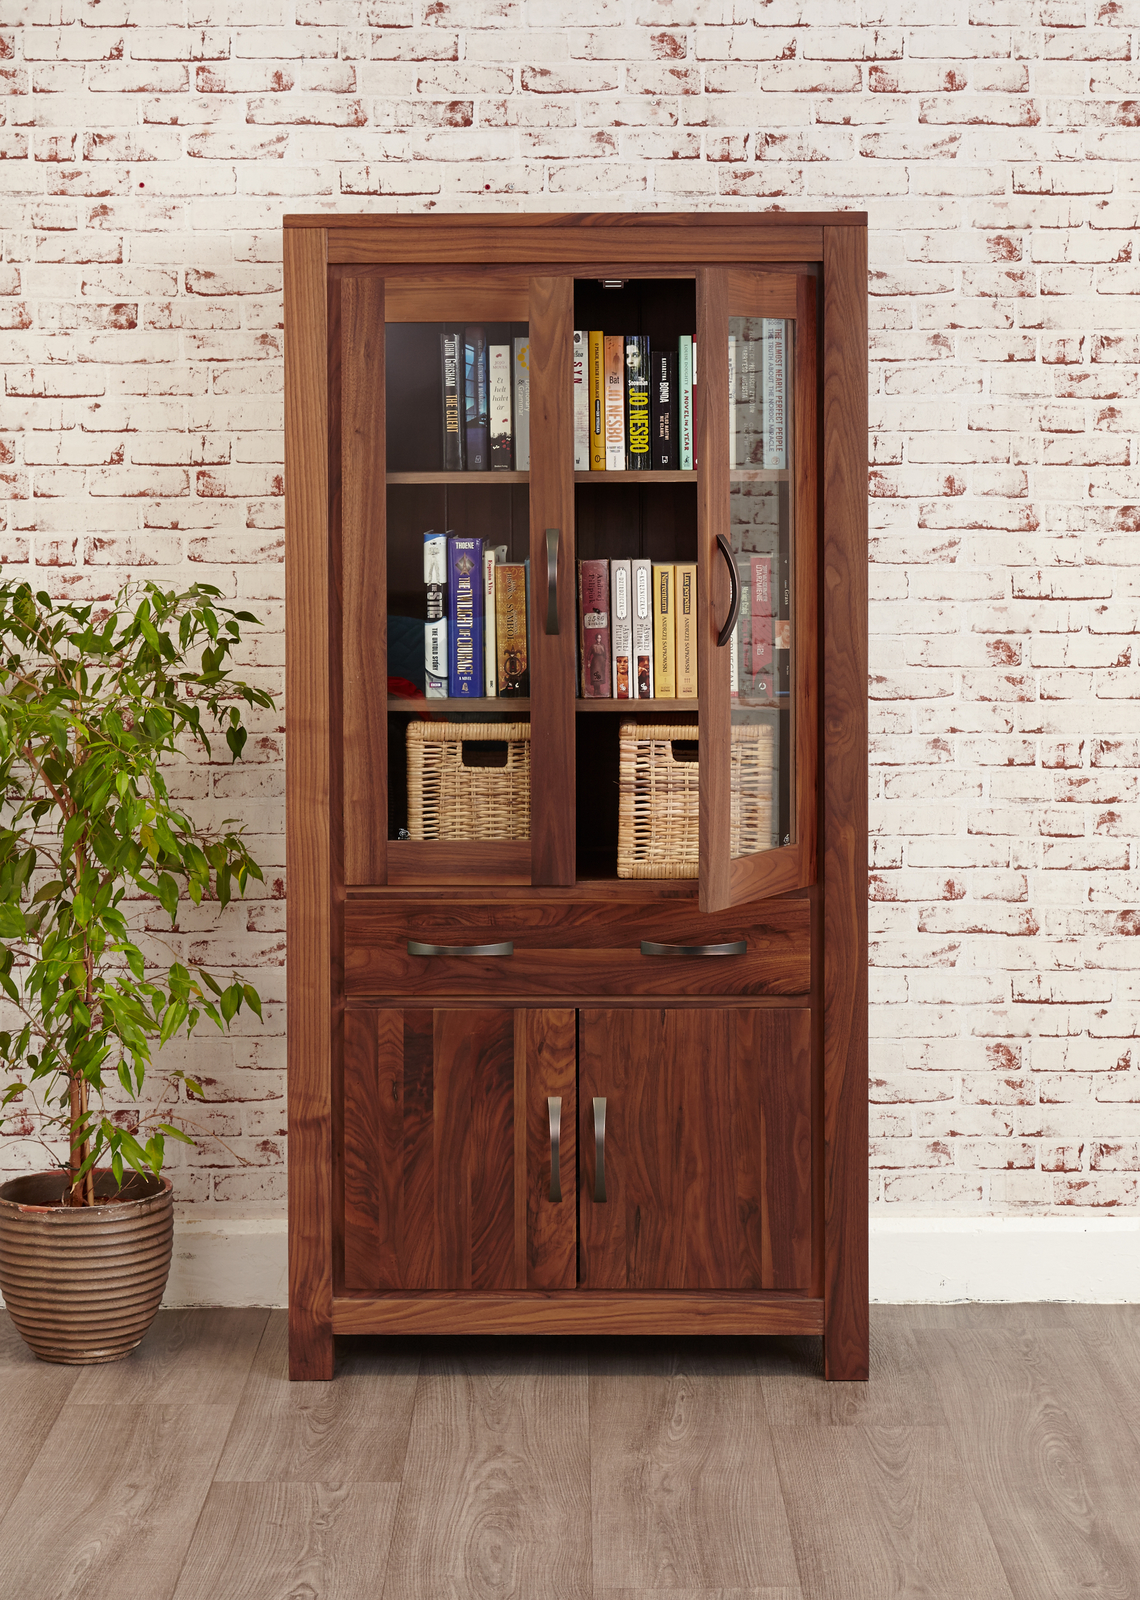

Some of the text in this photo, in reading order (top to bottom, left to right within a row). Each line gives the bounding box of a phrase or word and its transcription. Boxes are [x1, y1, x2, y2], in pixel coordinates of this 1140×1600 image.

[444, 339, 457, 387] JOHN GRISHAM
[573, 361, 583, 384] SYN
[609, 376, 620, 384] Bat
[659, 381, 669, 404] BONDA
[775, 328, 783, 452] THE ALMOST NEARLY PERFECT PEOPLE
[446, 394, 459, 433] THE CLIENT
[606, 386, 624, 443] JO NESBO
[628, 387, 649, 454] JO NESBO
[684, 419, 689, 427] IN
[455, 541, 474, 550] THOENE
[458, 577, 470, 589] THE
[661, 573, 669, 612] Narrenturm
[427, 591, 443, 619] STIG
[457, 588, 473, 629] TWILIGHT
[683, 586, 691, 614] perpetua
[459, 628, 470, 637] OF
[506, 603, 514, 642] SYMBOL
[457, 637, 473, 675] COURAGE
